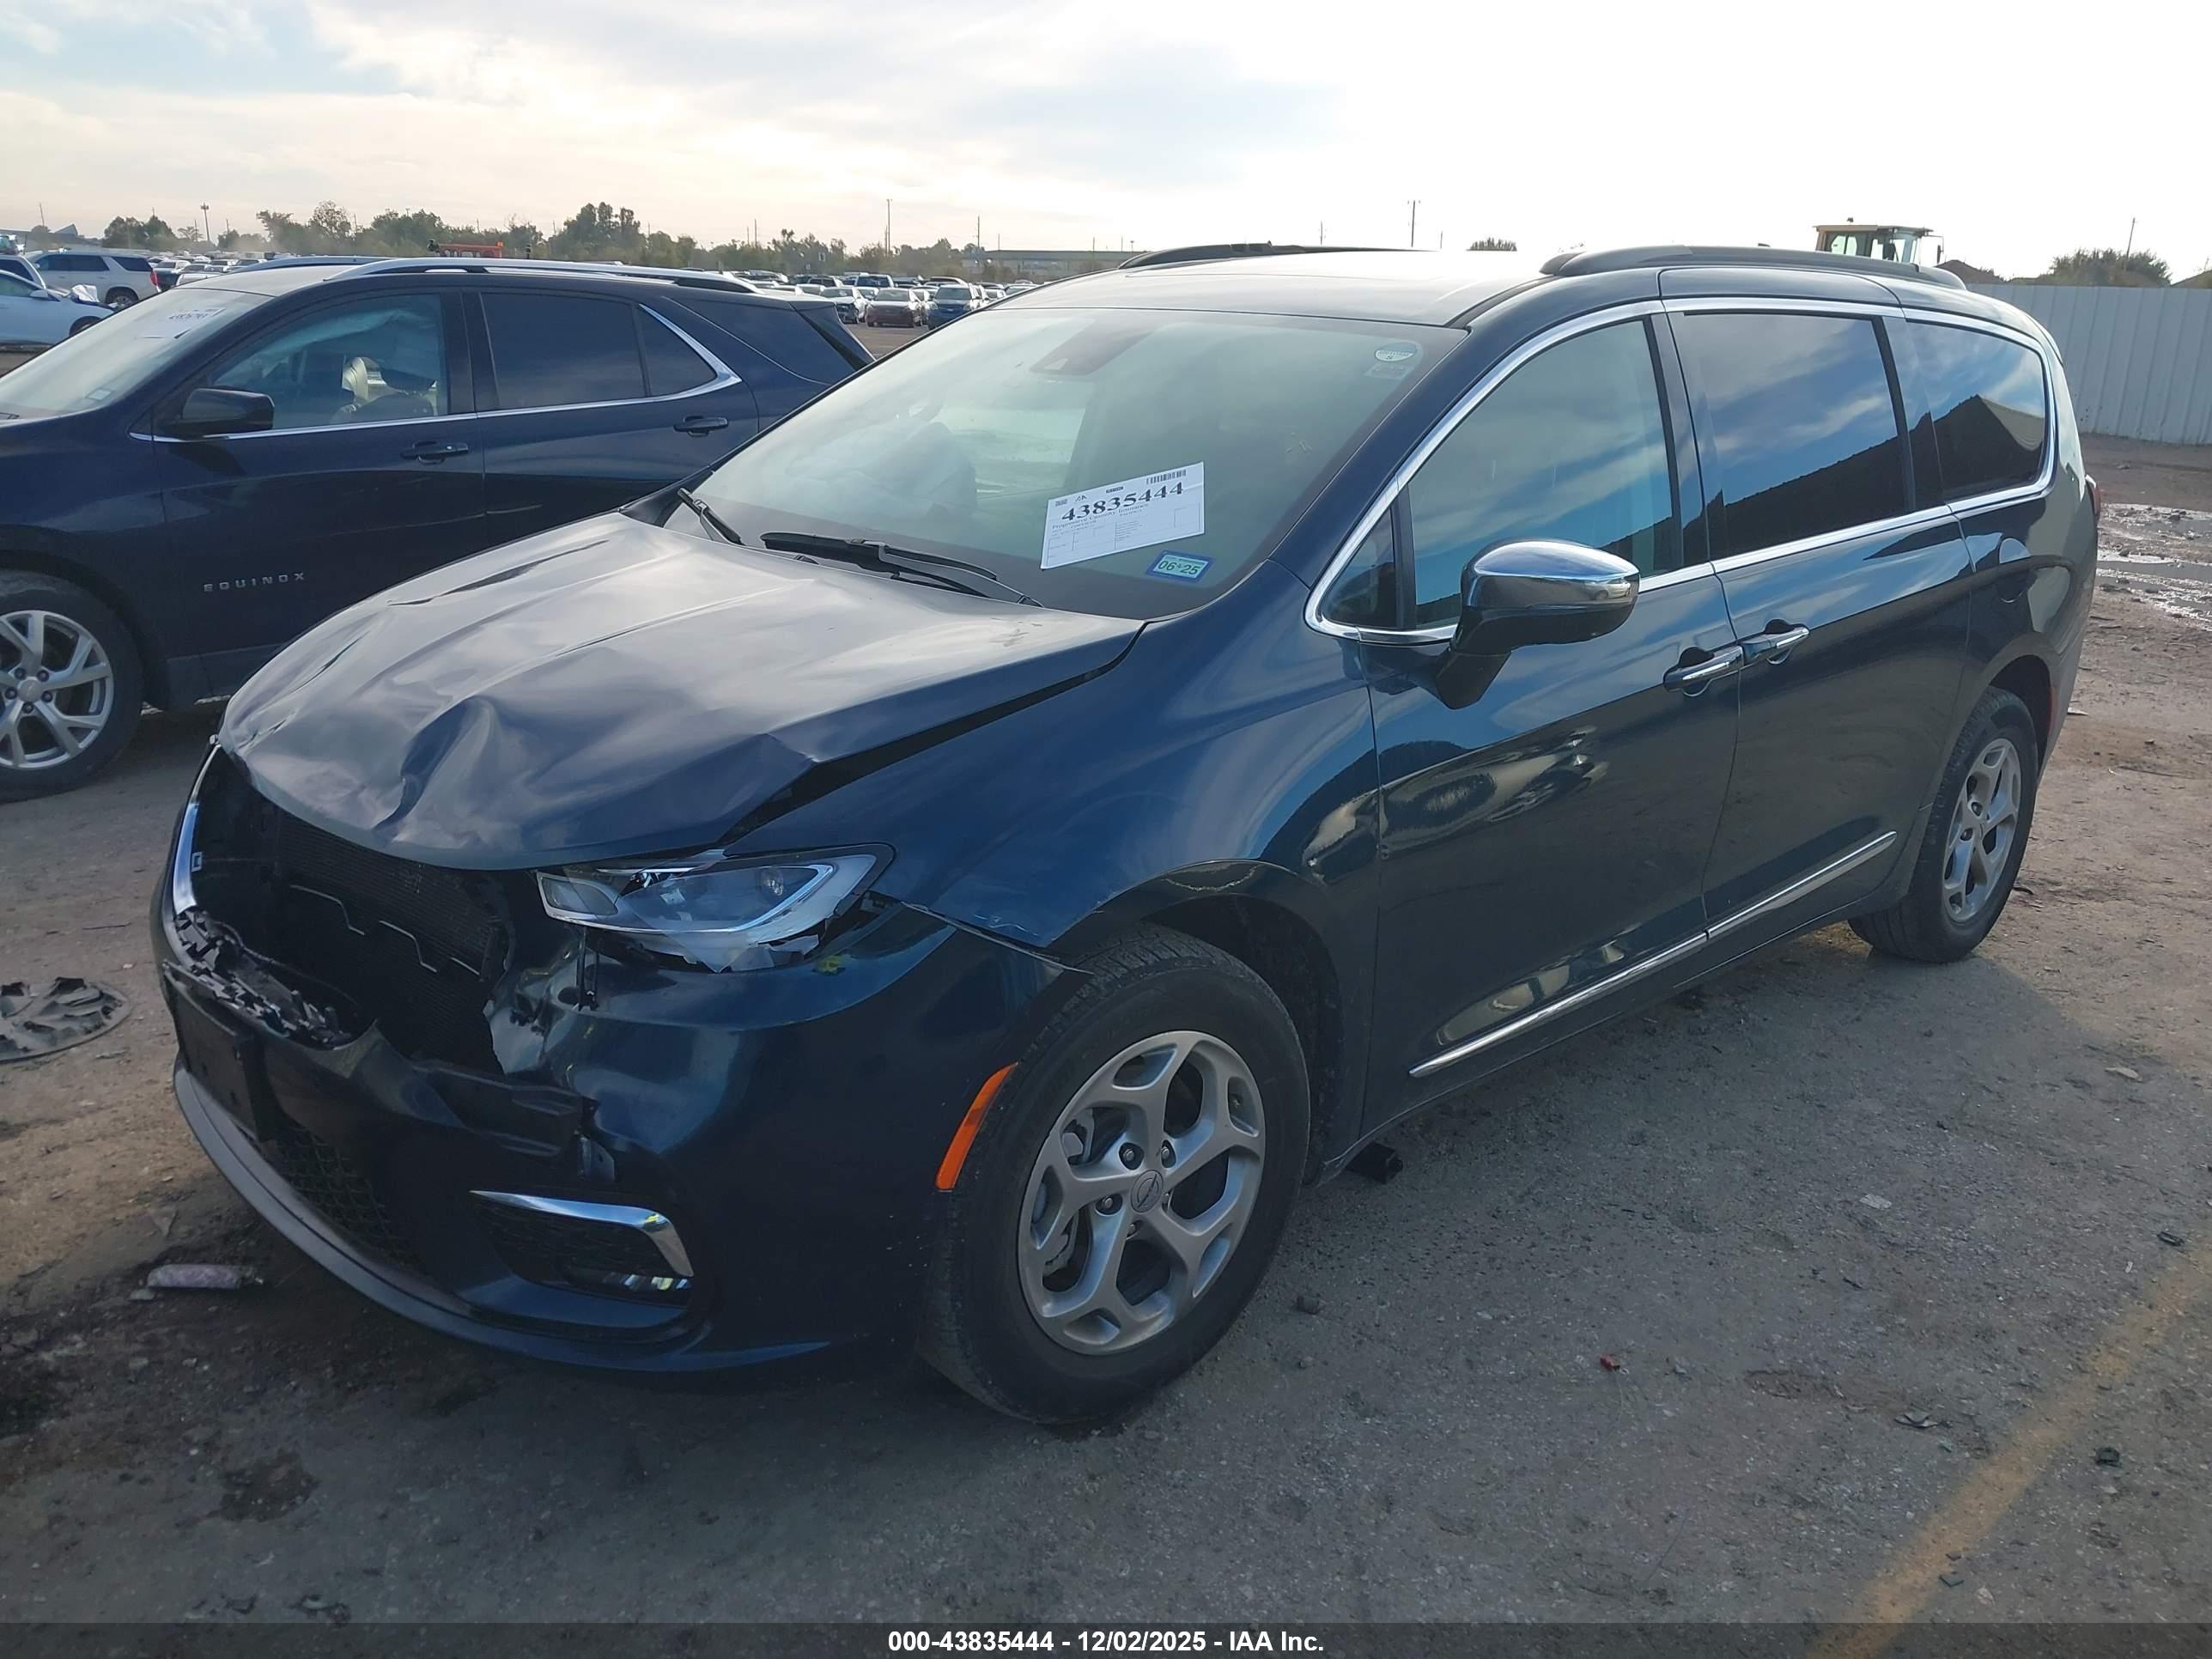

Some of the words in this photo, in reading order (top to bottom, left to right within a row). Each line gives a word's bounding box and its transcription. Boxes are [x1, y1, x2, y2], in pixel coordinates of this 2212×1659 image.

[1061, 482, 1183, 520] 43835444
[1158, 561, 1177, 571] 06
[1180, 564, 1200, 574] 25
[204, 573, 305, 592] EQUINOX
